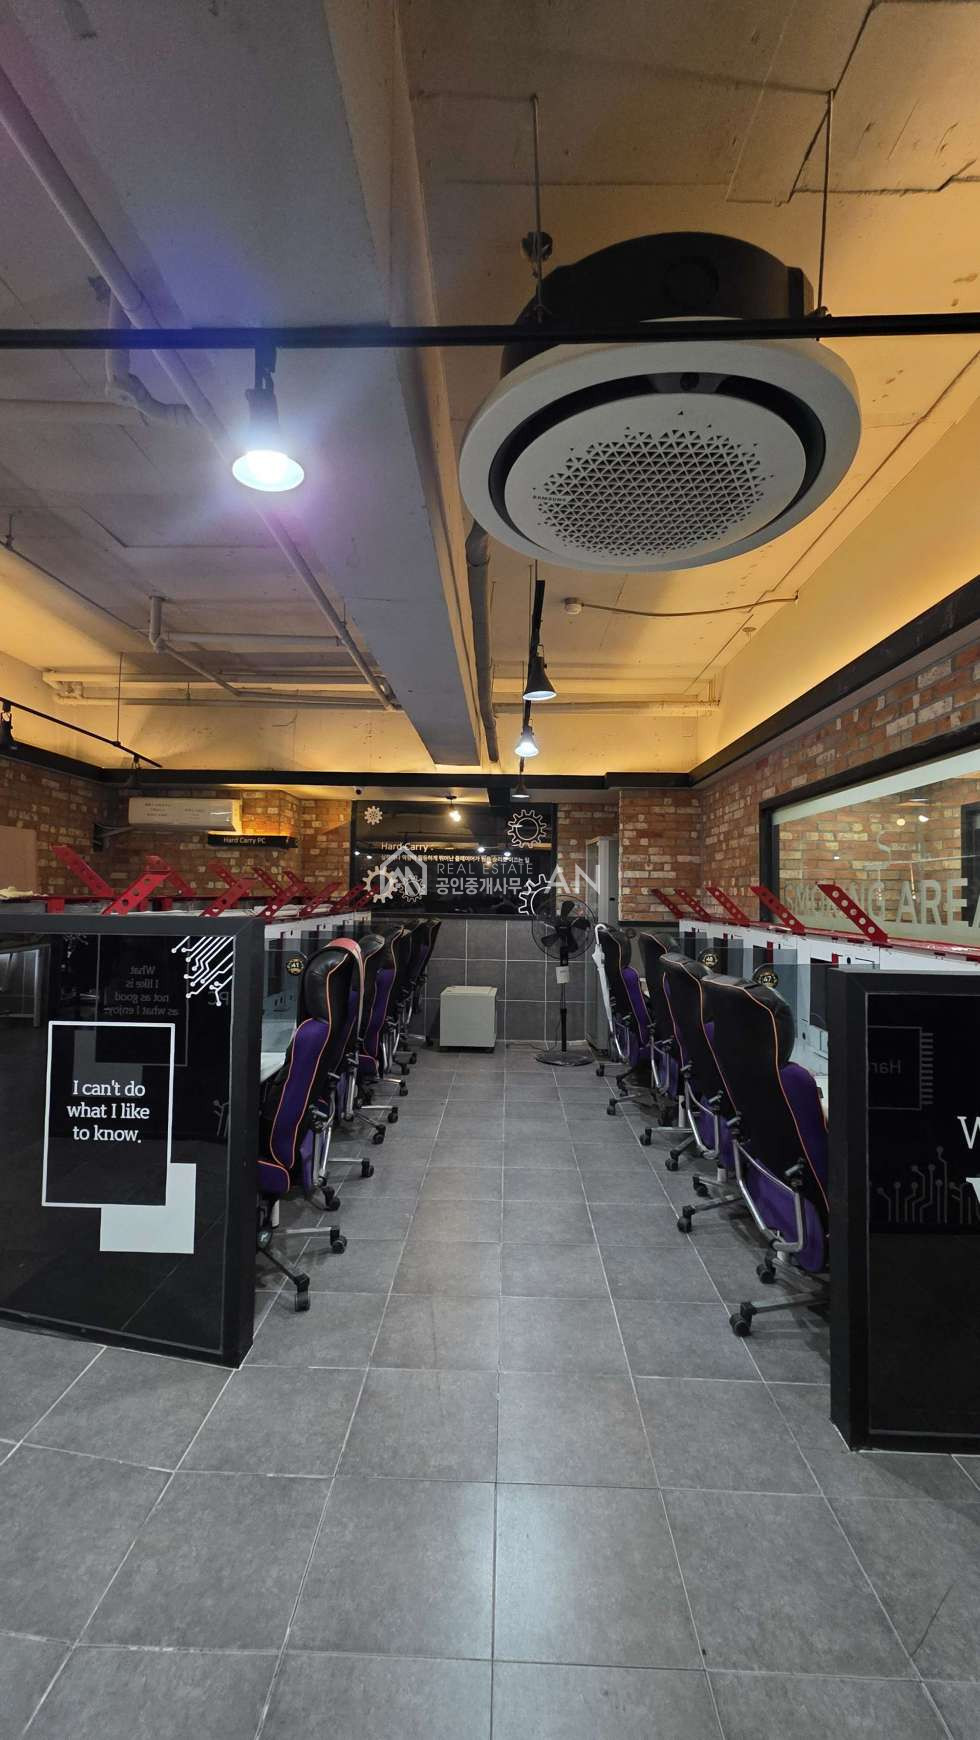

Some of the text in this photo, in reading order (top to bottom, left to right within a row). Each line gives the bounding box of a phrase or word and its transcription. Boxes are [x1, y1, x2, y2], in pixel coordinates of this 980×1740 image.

[240, 837, 256, 845] Carry
[381, 841, 402, 851] Hard
[405, 842, 429, 852] Carry
[896, 878, 980, 928] ARE
[73, 1080, 146, 1096] I can't do
[66, 1102, 150, 1120] what I like
[73, 1125, 142, 1144] to know.
